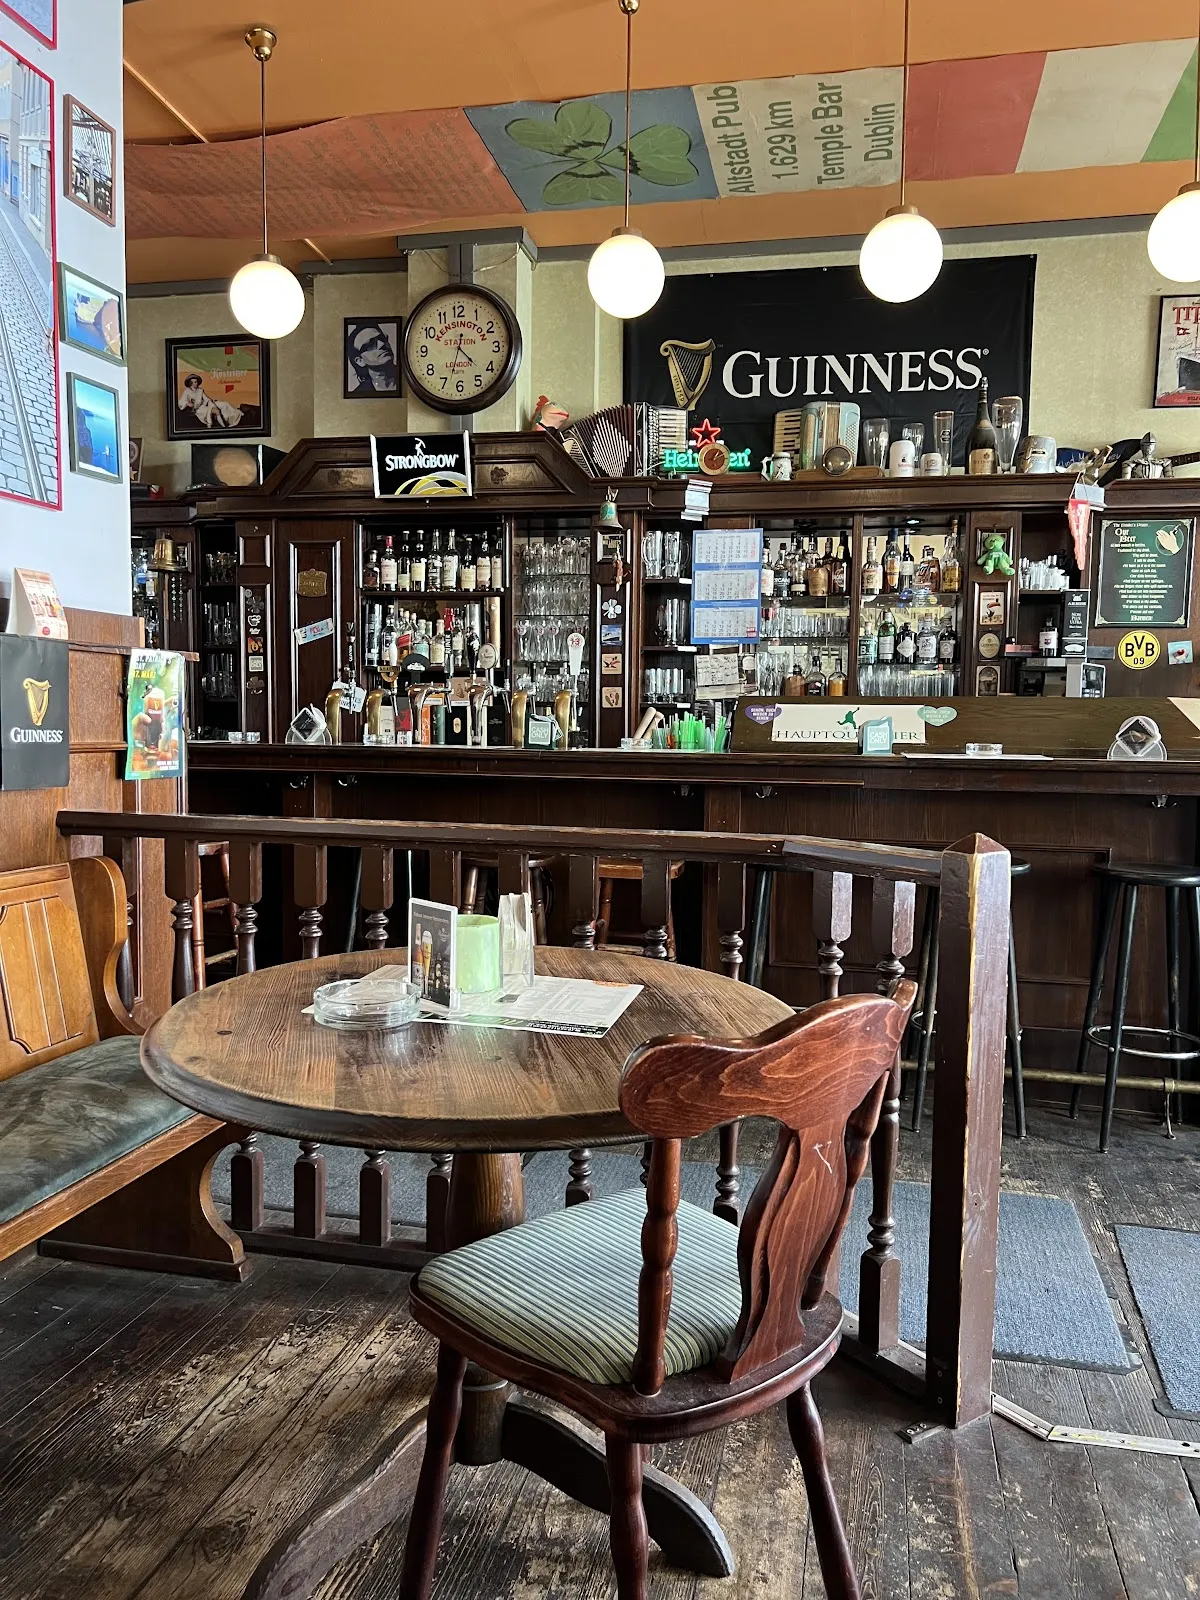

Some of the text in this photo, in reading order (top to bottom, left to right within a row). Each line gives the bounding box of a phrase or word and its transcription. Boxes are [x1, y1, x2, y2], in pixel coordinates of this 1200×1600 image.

[811, 81, 853, 185] Temple Bar
[863, 102, 896, 163] Dublin
[706, 85, 756, 194] Altstadt Pub
[764, 100, 799, 180] 1.629 km
[438, 311, 447, 324] 11
[453, 305, 465, 318] 12
[474, 308, 478, 321] 1
[1172, 306, 1200, 325] TIT
[424, 326, 436, 339] 10
[435, 320, 487, 342] KENSINGTON
[486, 321, 494, 334] 2
[420, 345, 428, 357] 9
[492, 340, 500, 353] 3
[426, 364, 434, 376] 8
[486, 361, 494, 373] 4
[722, 348, 983, 399] GUINNESS
[440, 377, 448, 390] 7
[456, 380, 464, 392] 6
[474, 375, 482, 387] 5
[384, 454, 456, 472] STRONGBOW
[664, 448, 750, 468] Heien
[1114, 528, 1130, 536] Our
[1125, 635, 1154, 657] BVB
[10, 727, 63, 743] GUINNESS
[776, 730, 918, 740] HAUPTQUIER
